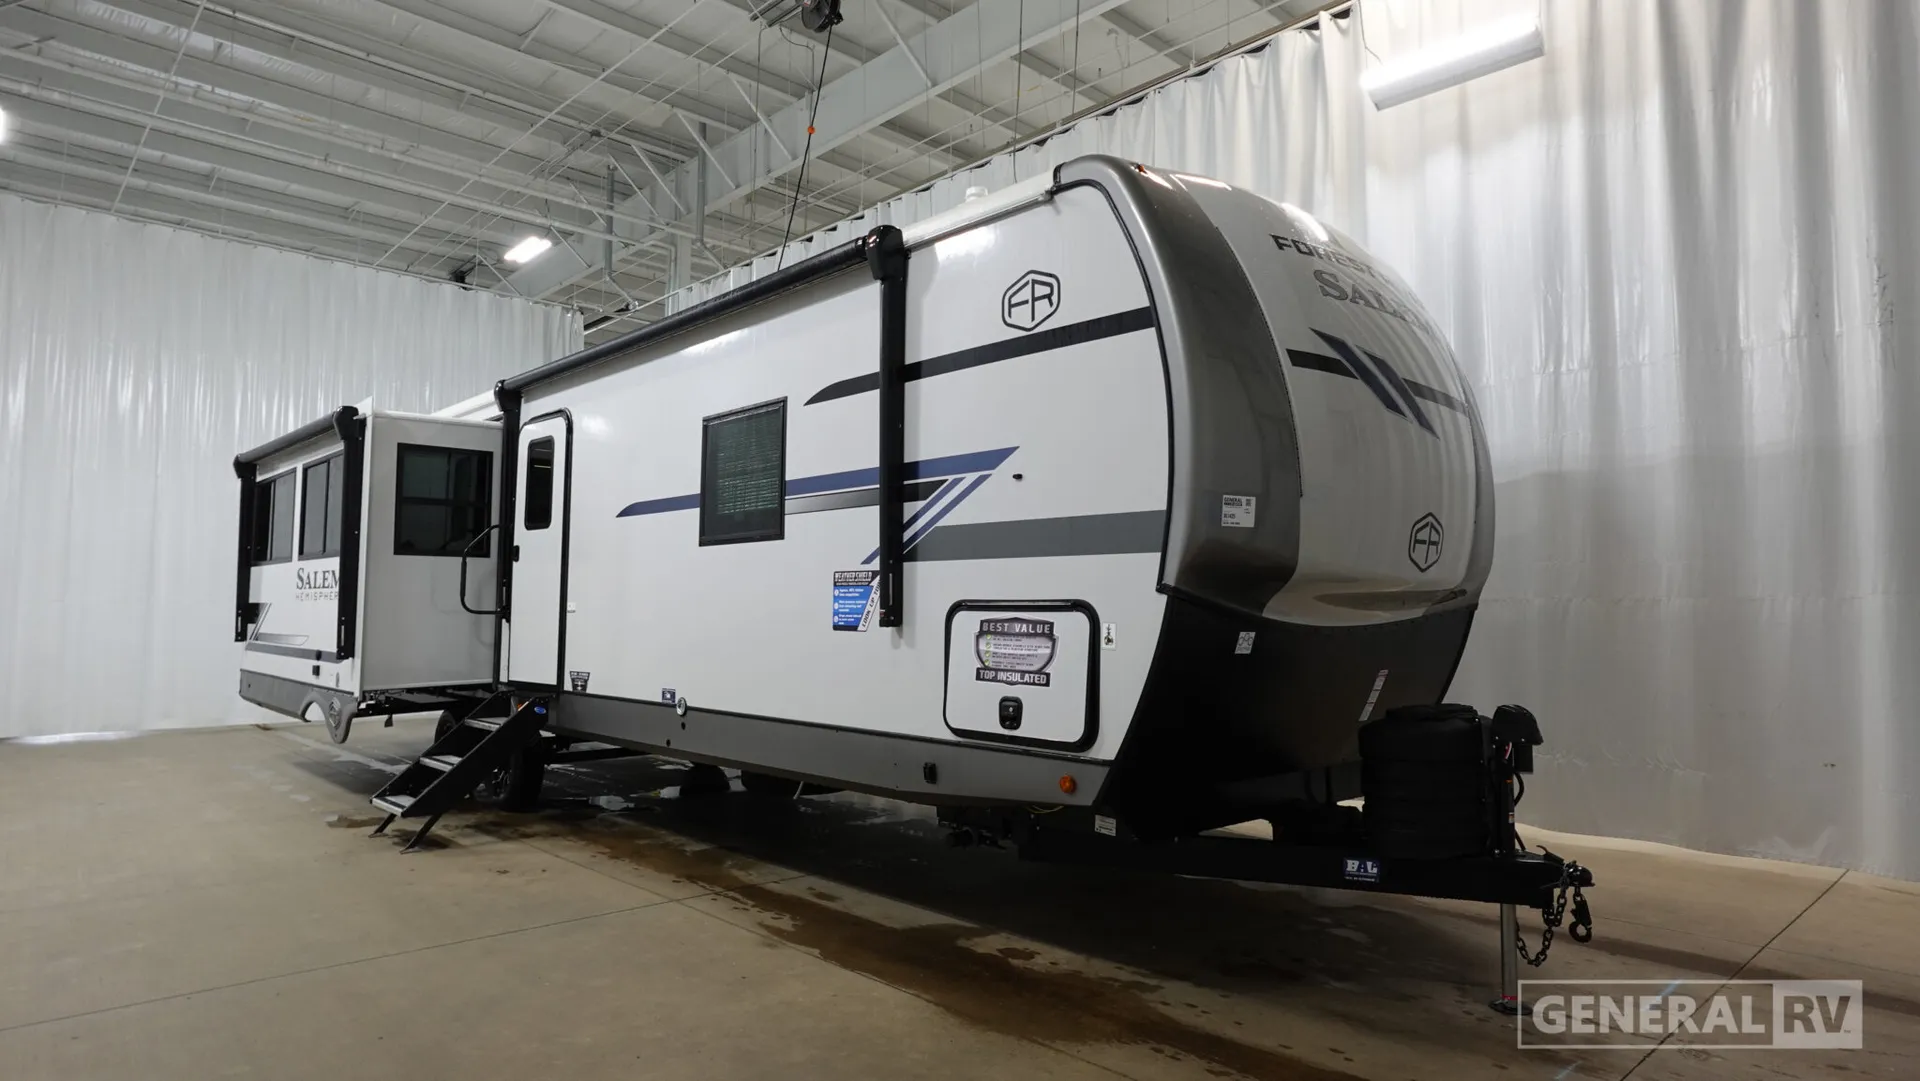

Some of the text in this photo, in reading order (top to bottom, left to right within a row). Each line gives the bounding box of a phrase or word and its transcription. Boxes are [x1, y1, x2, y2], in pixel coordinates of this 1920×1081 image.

[1007, 277, 1055, 323] FR
[295, 591, 339, 601] HEMISPHER
[982, 622, 1051, 634] BEST VALUE
[979, 670, 1047, 684] TOP INSULATED
